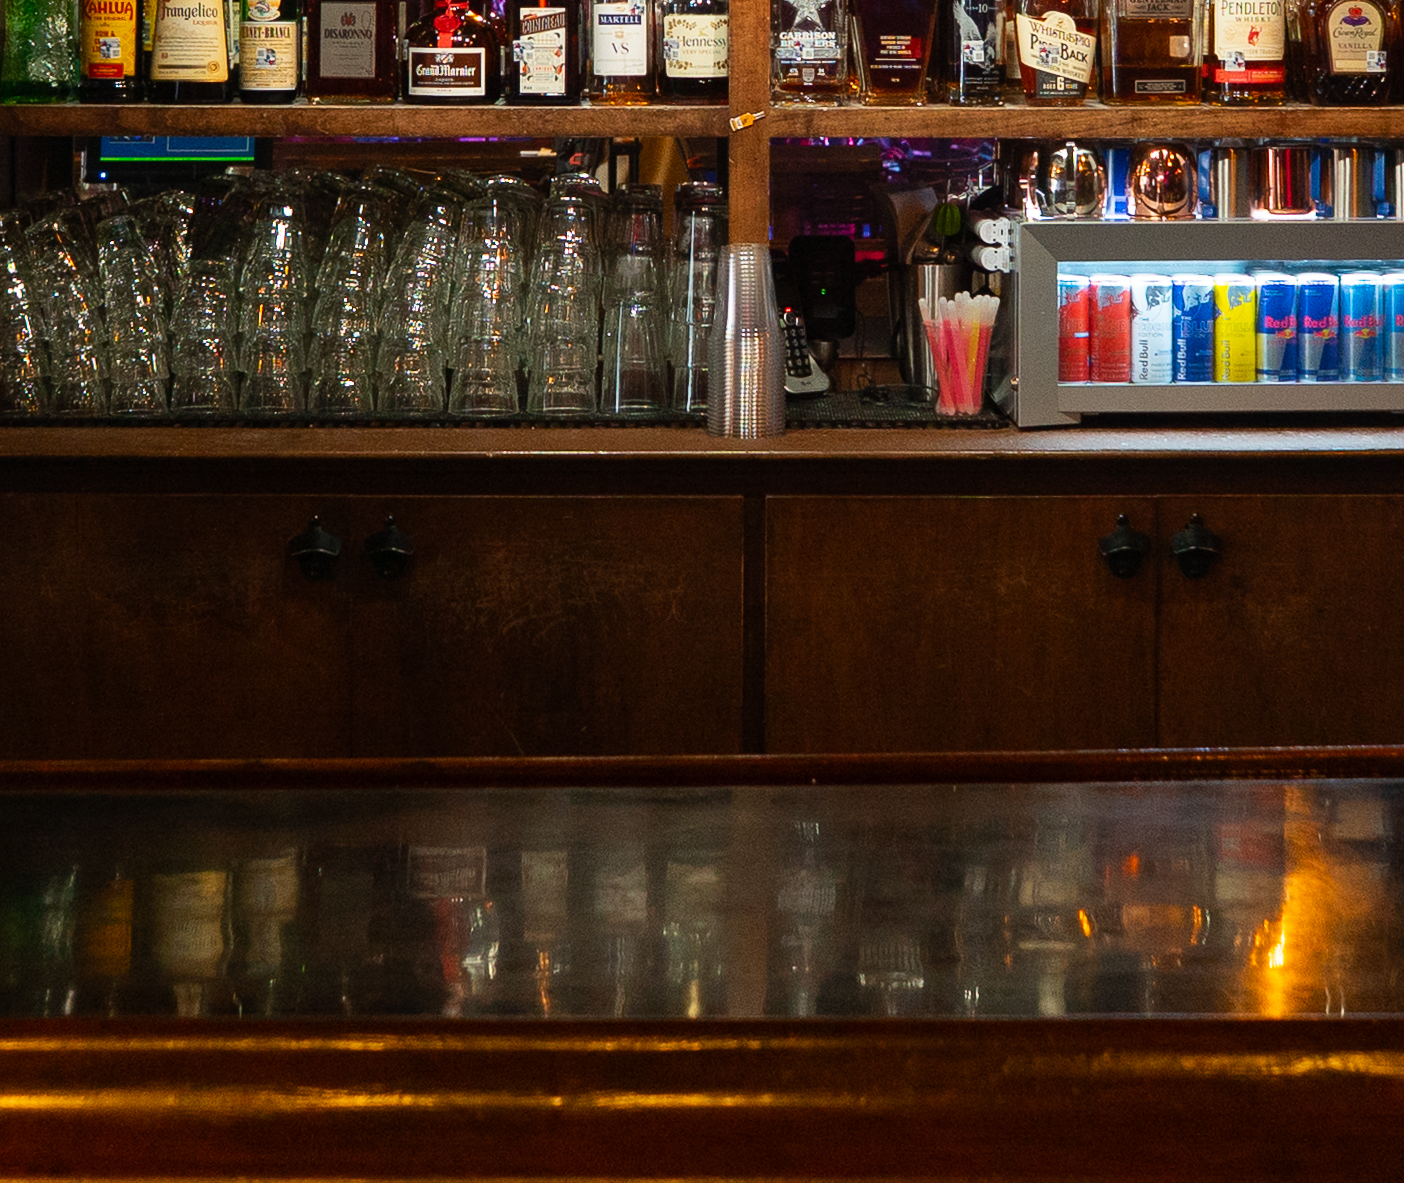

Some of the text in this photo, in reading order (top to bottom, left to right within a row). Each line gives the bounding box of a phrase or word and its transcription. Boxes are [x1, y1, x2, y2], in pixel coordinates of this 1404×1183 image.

[1148, 3, 1170, 12] JACK
[1221, 0, 1282, 16] PENDLETON
[522, 13, 565, 34] COINTREAU
[600, 15, 640, 24] MARTELL
[324, 28, 373, 41] DISARONNO
[779, 31, 837, 40] GARRISON
[612, 42, 630, 56] VS
[1338, 42, 1373, 50] VANILLA
[415, 65, 476, 77] Grand Marnier
[1057, 77, 1065, 91] 6
[1265, 315, 1288, 329] Red
[1303, 315, 1326, 329] Red
[1139, 339, 1149, 381] Red Bull
[1177, 339, 1187, 381] Red Bull
